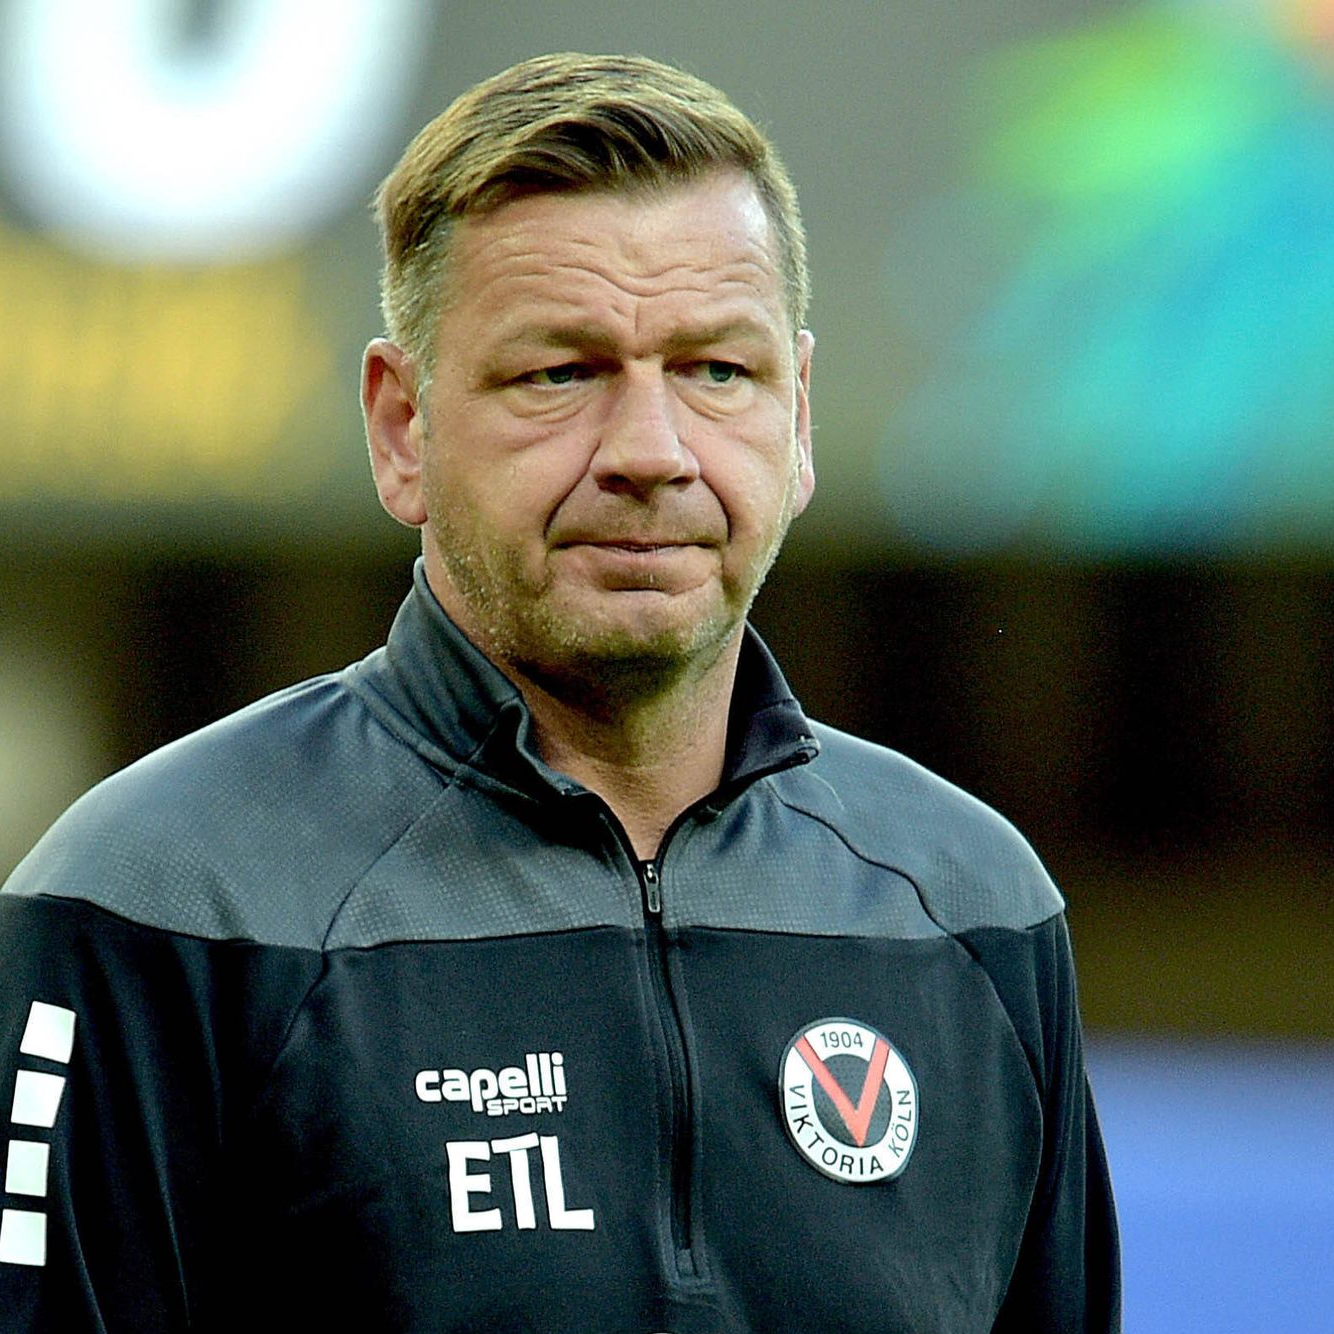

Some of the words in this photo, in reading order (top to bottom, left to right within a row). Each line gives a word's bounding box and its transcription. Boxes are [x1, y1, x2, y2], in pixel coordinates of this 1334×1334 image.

[820, 1031, 863, 1048] 1904
[415, 1052, 567, 1113] capelli
[486, 1096, 568, 1116] SPORT
[789, 1085, 884, 1175] VIKTORIA
[888, 1089, 912, 1158] KÖLN
[445, 1132, 595, 1233] ETL
